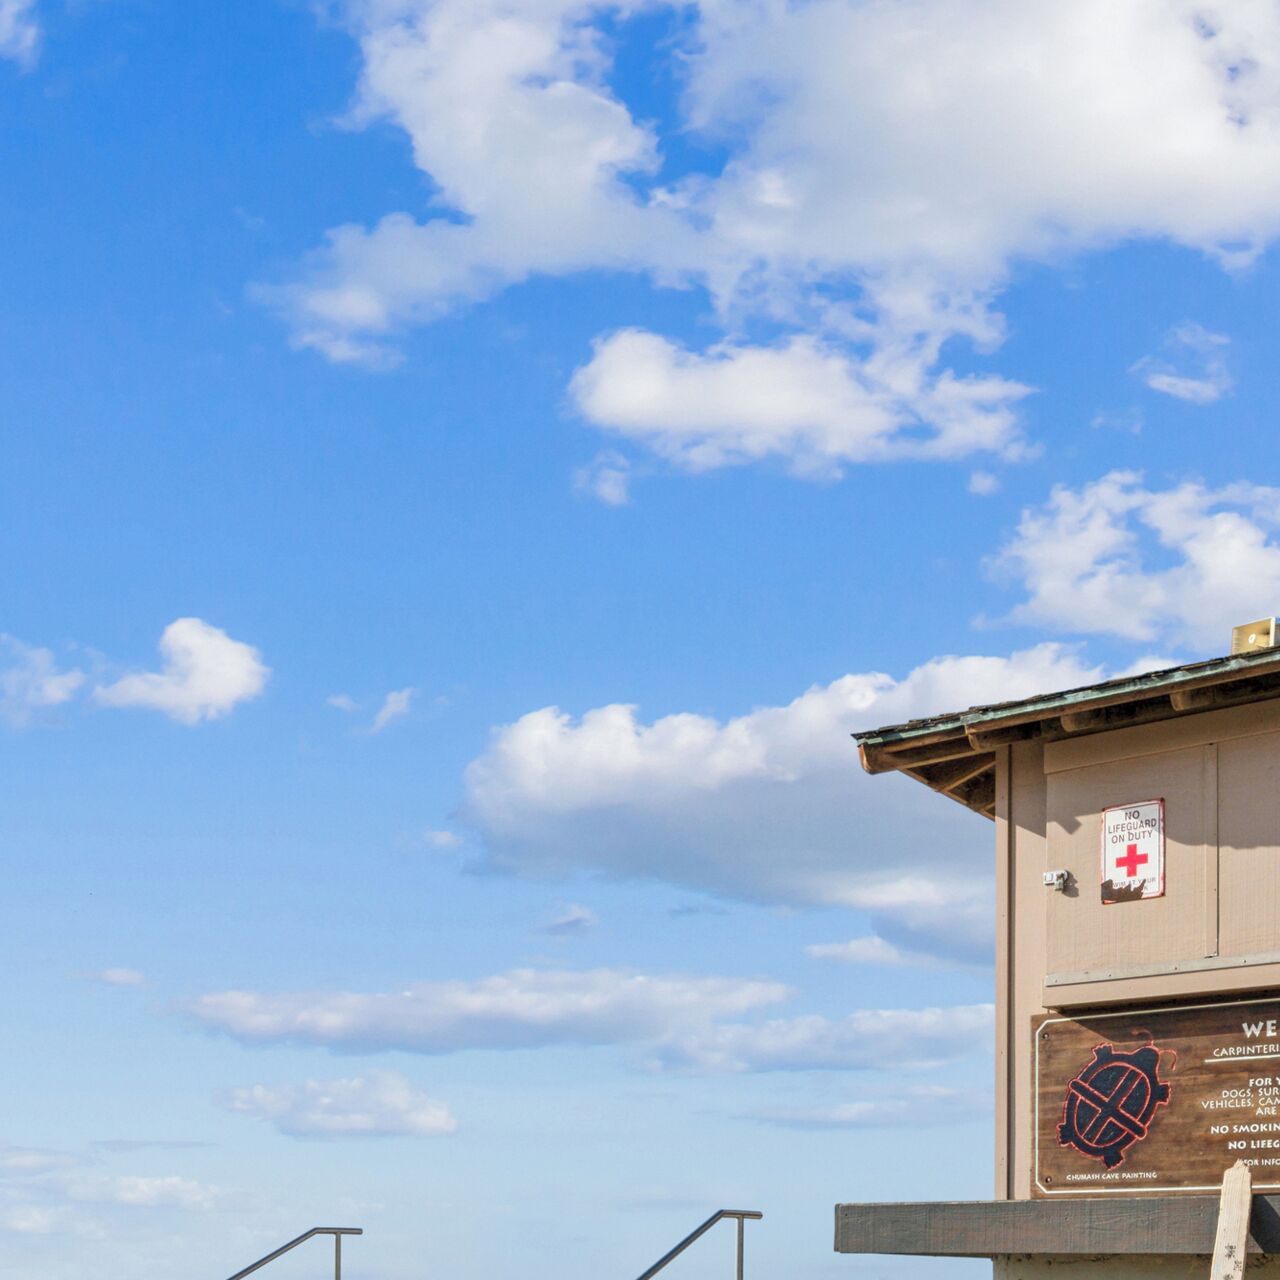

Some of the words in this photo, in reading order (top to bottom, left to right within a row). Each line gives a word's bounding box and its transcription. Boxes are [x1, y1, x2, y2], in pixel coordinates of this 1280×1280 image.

[1124, 810, 1140, 820] NO
[1108, 818, 1157, 834] LIFEGUARD
[1111, 834, 1125, 844] ON
[1128, 830, 1153, 841] DUTY
[1249, 1078, 1272, 1087] FOR
[1222, 1088, 1254, 1098] DOGS,
[1201, 1098, 1254, 1109] VEHICLES,
[1256, 1106, 1277, 1115] ARE
[1211, 1125, 1229, 1134] NO
[1228, 1141, 1246, 1150] NO
